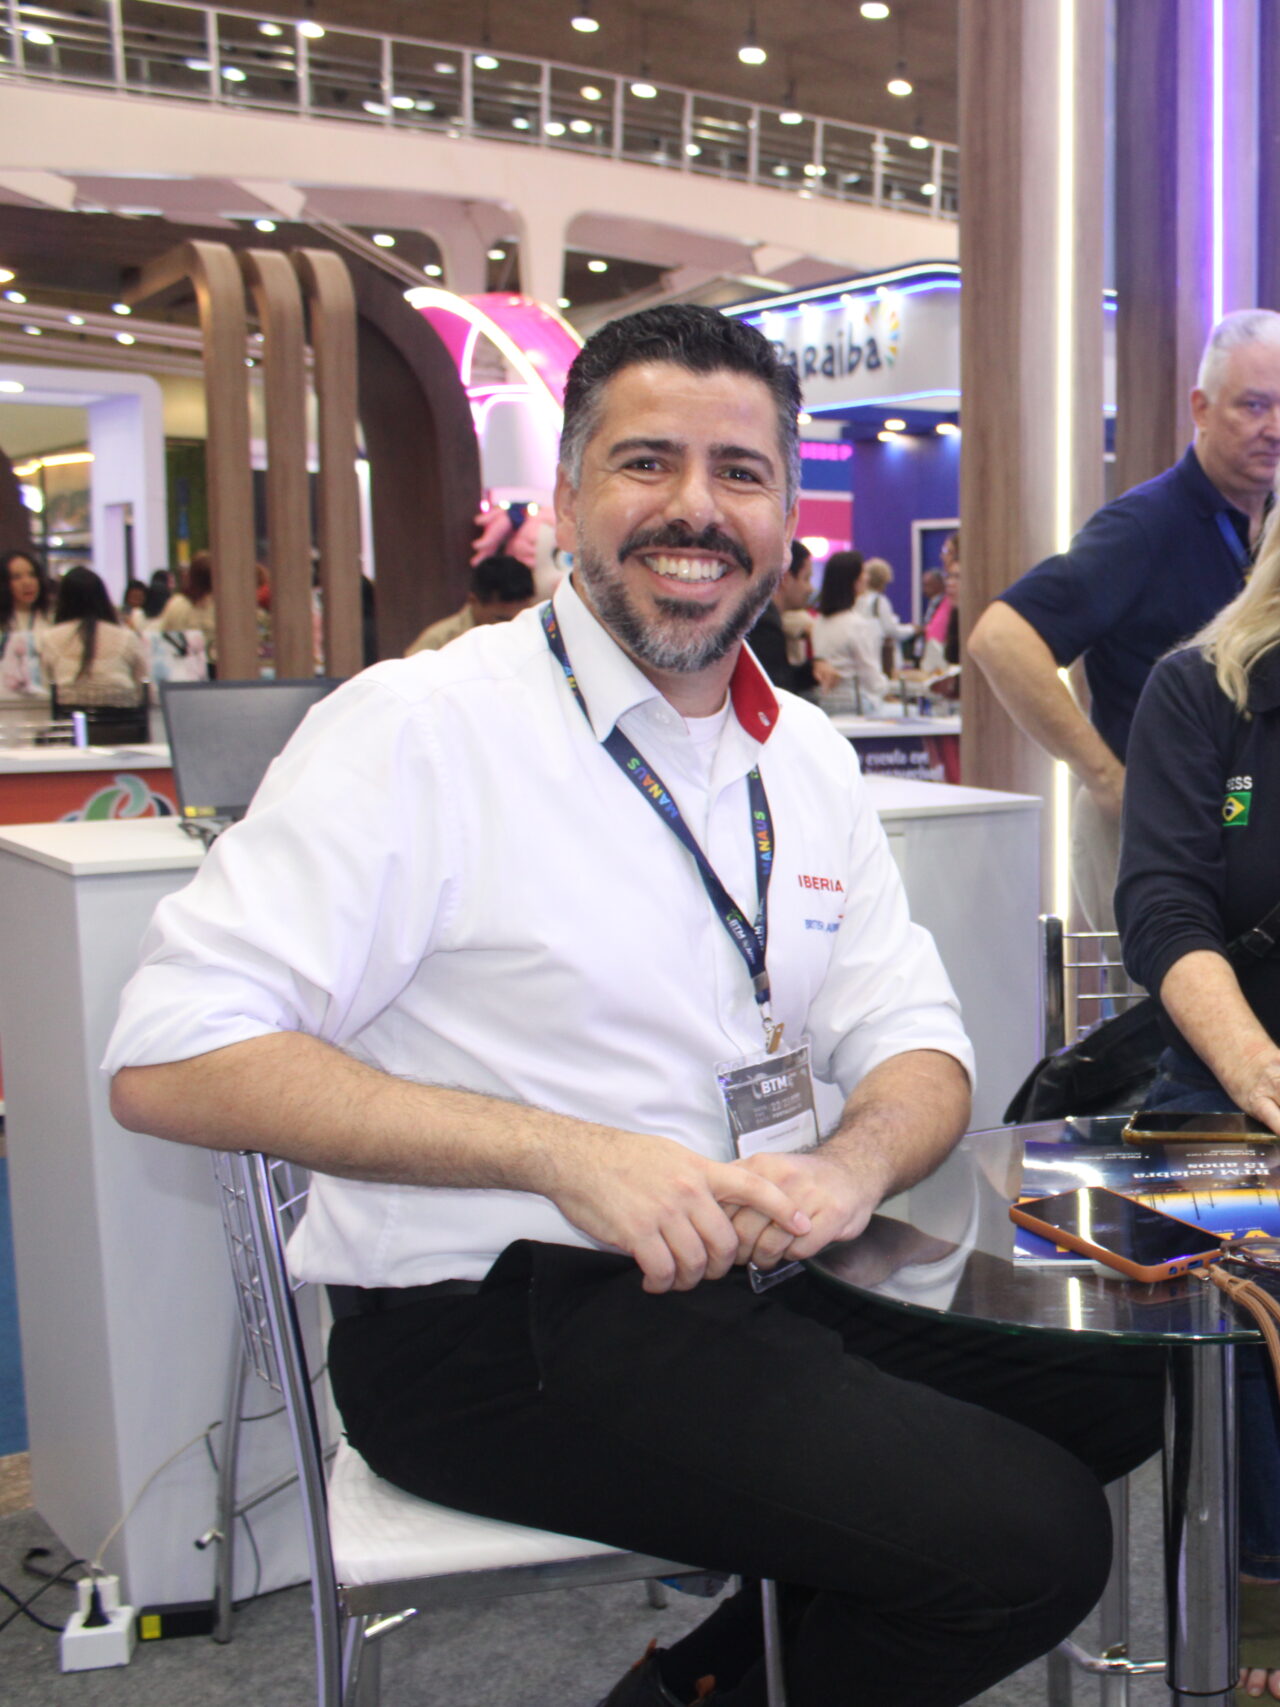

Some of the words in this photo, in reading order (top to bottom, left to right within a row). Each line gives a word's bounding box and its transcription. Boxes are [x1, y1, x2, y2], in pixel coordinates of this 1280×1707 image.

[627, 757, 679, 819] MANAUS
[753, 810, 773, 875] MANAUS
[797, 874, 844, 893] IBERIA
[761, 1075, 790, 1095] BTM
